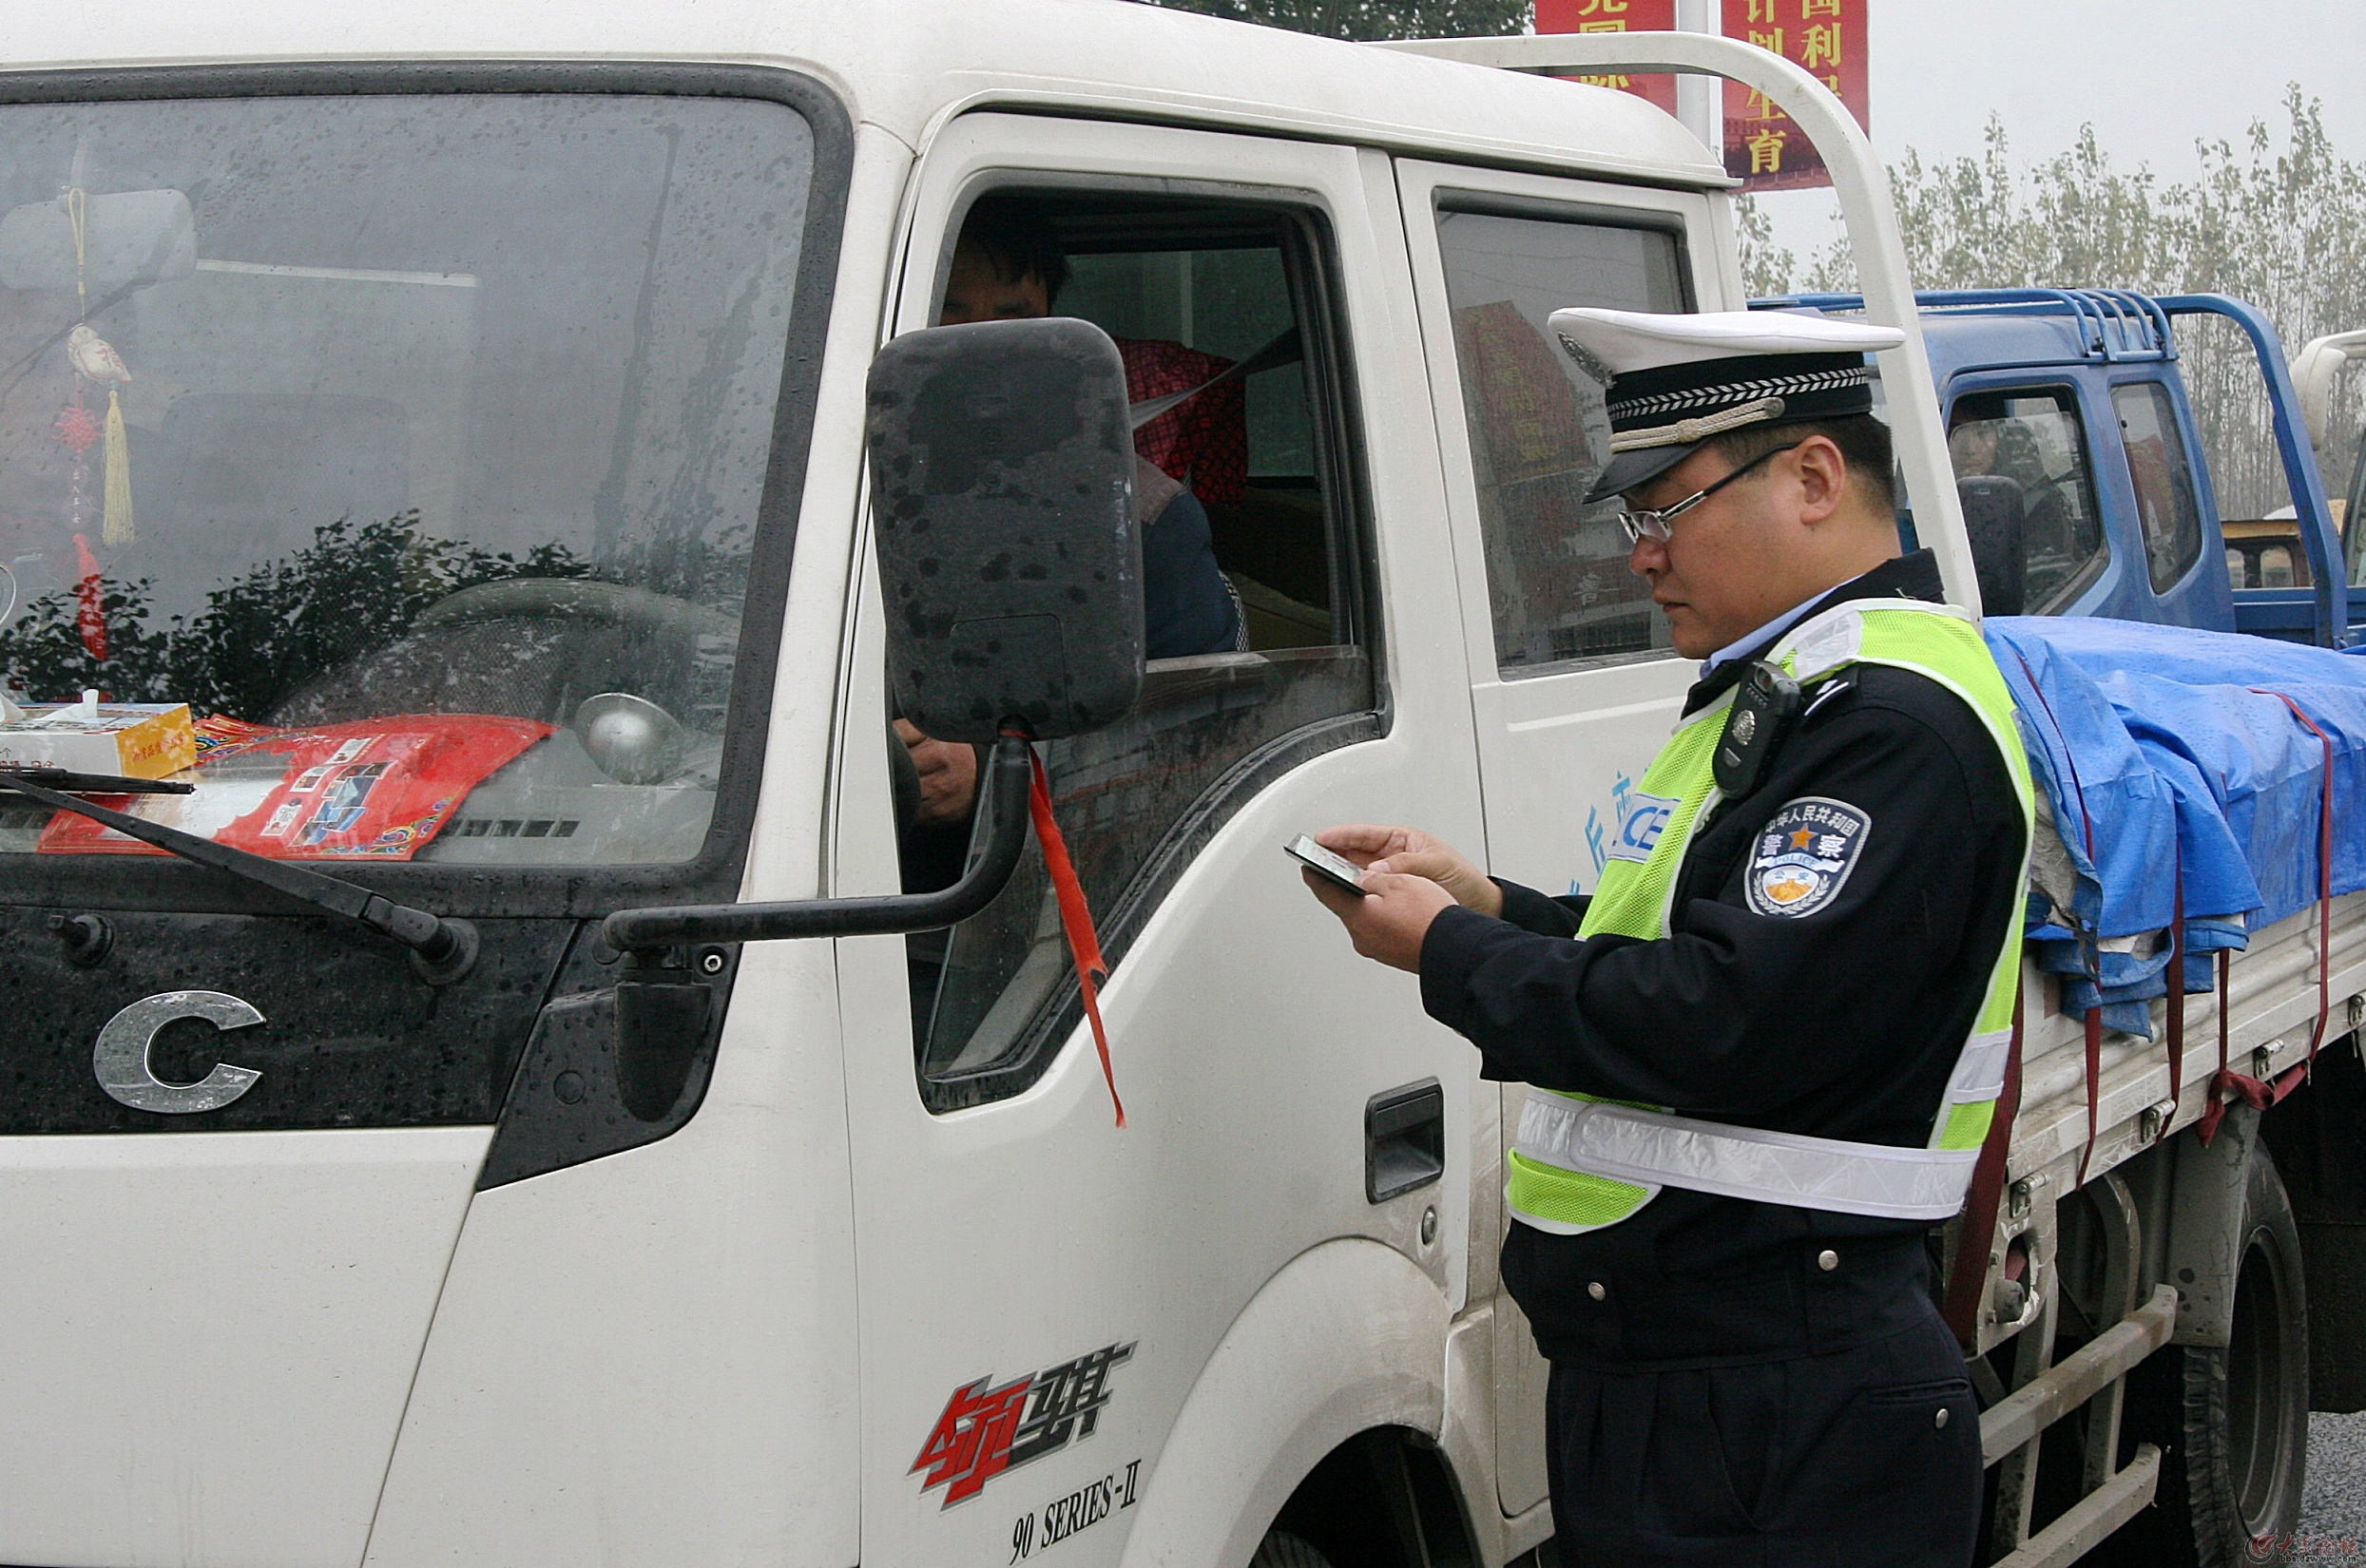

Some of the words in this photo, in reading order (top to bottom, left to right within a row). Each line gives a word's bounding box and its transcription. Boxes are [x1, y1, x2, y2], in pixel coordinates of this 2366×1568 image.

[1765, 805, 1860, 837] 中华人民共和国
[1774, 853, 1818, 869] POLICE
[93, 989, 267, 1114] C
[1010, 1512, 1033, 1565] 90
